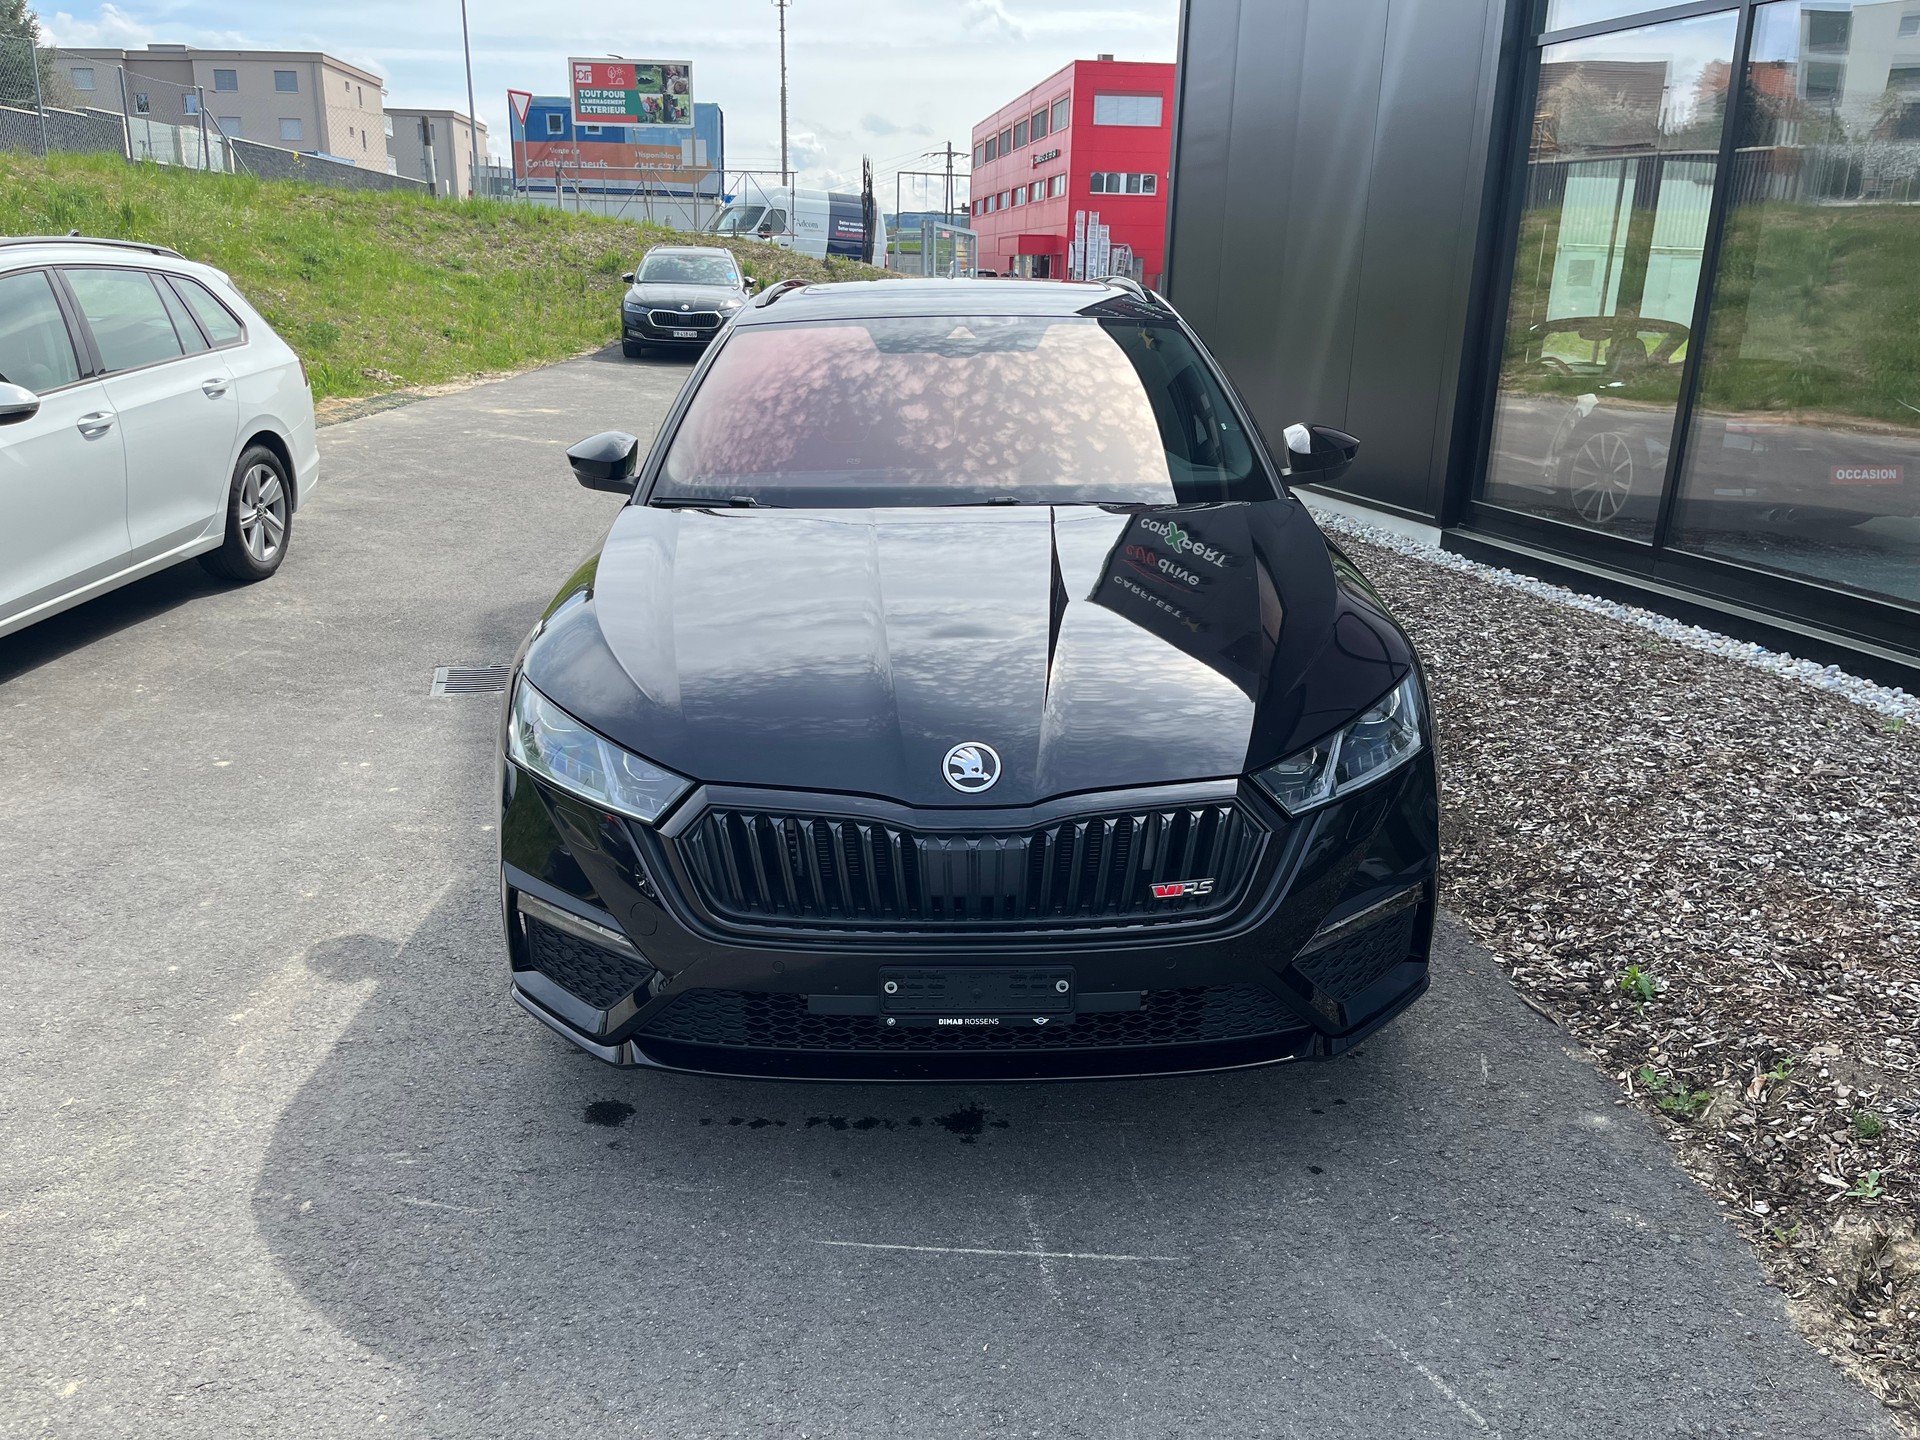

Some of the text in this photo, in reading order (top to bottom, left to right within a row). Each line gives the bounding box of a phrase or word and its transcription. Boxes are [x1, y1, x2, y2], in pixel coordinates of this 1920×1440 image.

[579, 89, 626, 99] TOUT POUR
[580, 105, 627, 114] EXTERIEUR
[1836, 469, 1897, 480] OCCASION
[938, 1018, 963, 1026] DIMAB
